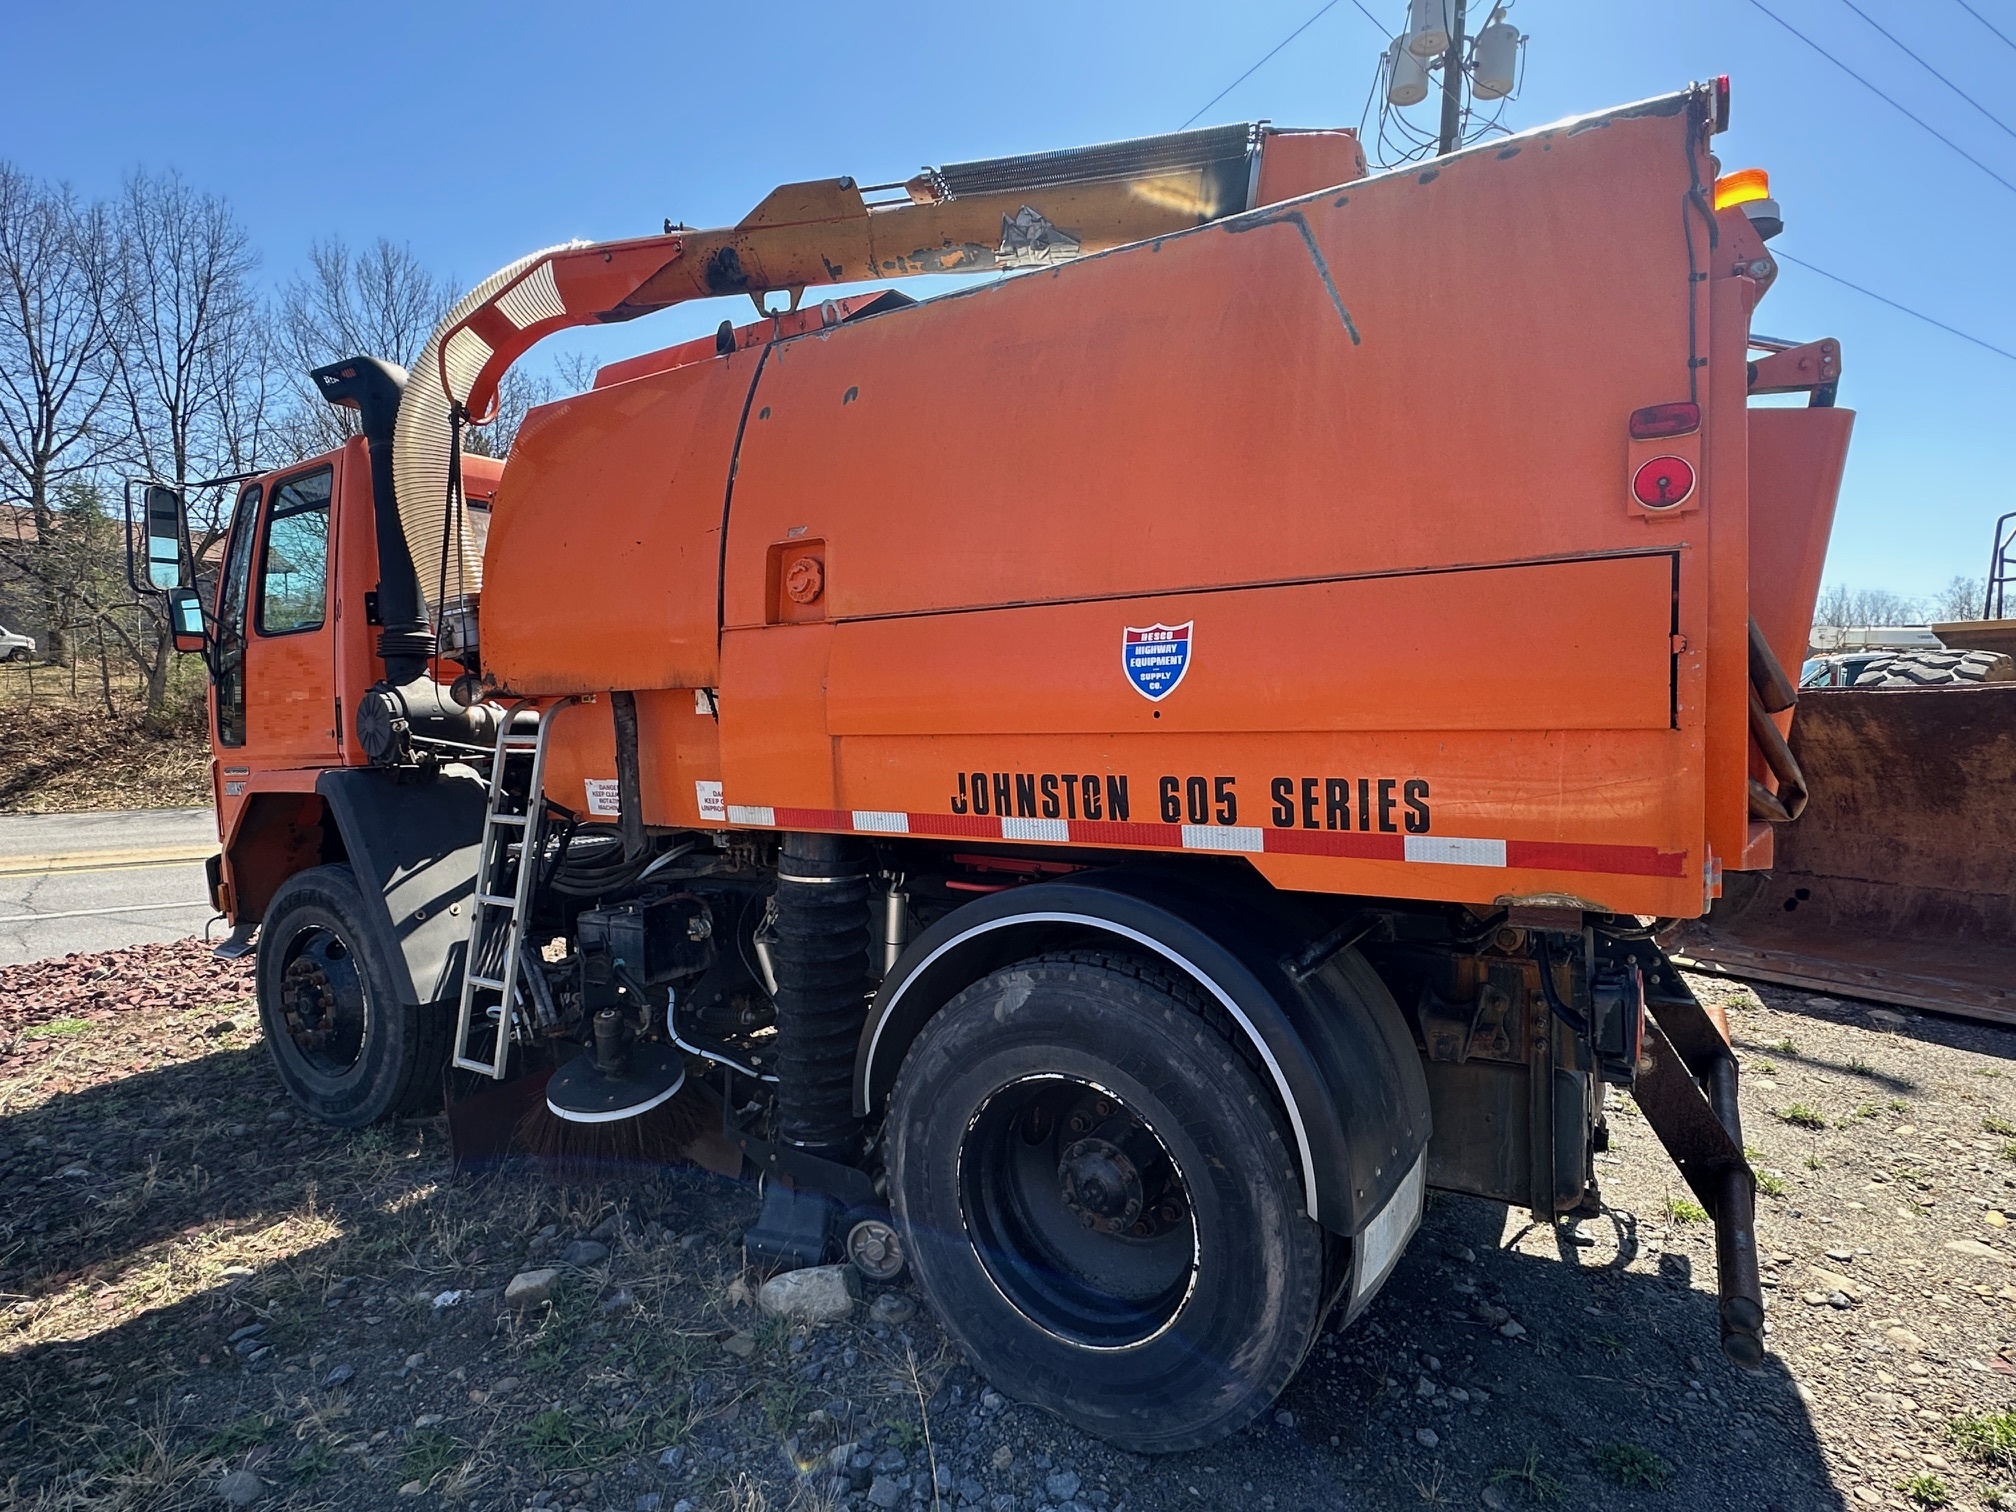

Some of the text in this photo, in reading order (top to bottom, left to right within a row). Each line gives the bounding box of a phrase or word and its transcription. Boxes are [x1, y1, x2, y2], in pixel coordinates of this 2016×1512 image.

[1135, 643, 1178, 655] HIGHWAY
[1130, 655, 1184, 668] EQUIPMENT
[1140, 671, 1172, 681] SUPPLY
[1149, 682, 1162, 690] CO.
[951, 771, 1431, 834] JOHNSTON 605 SERIES
